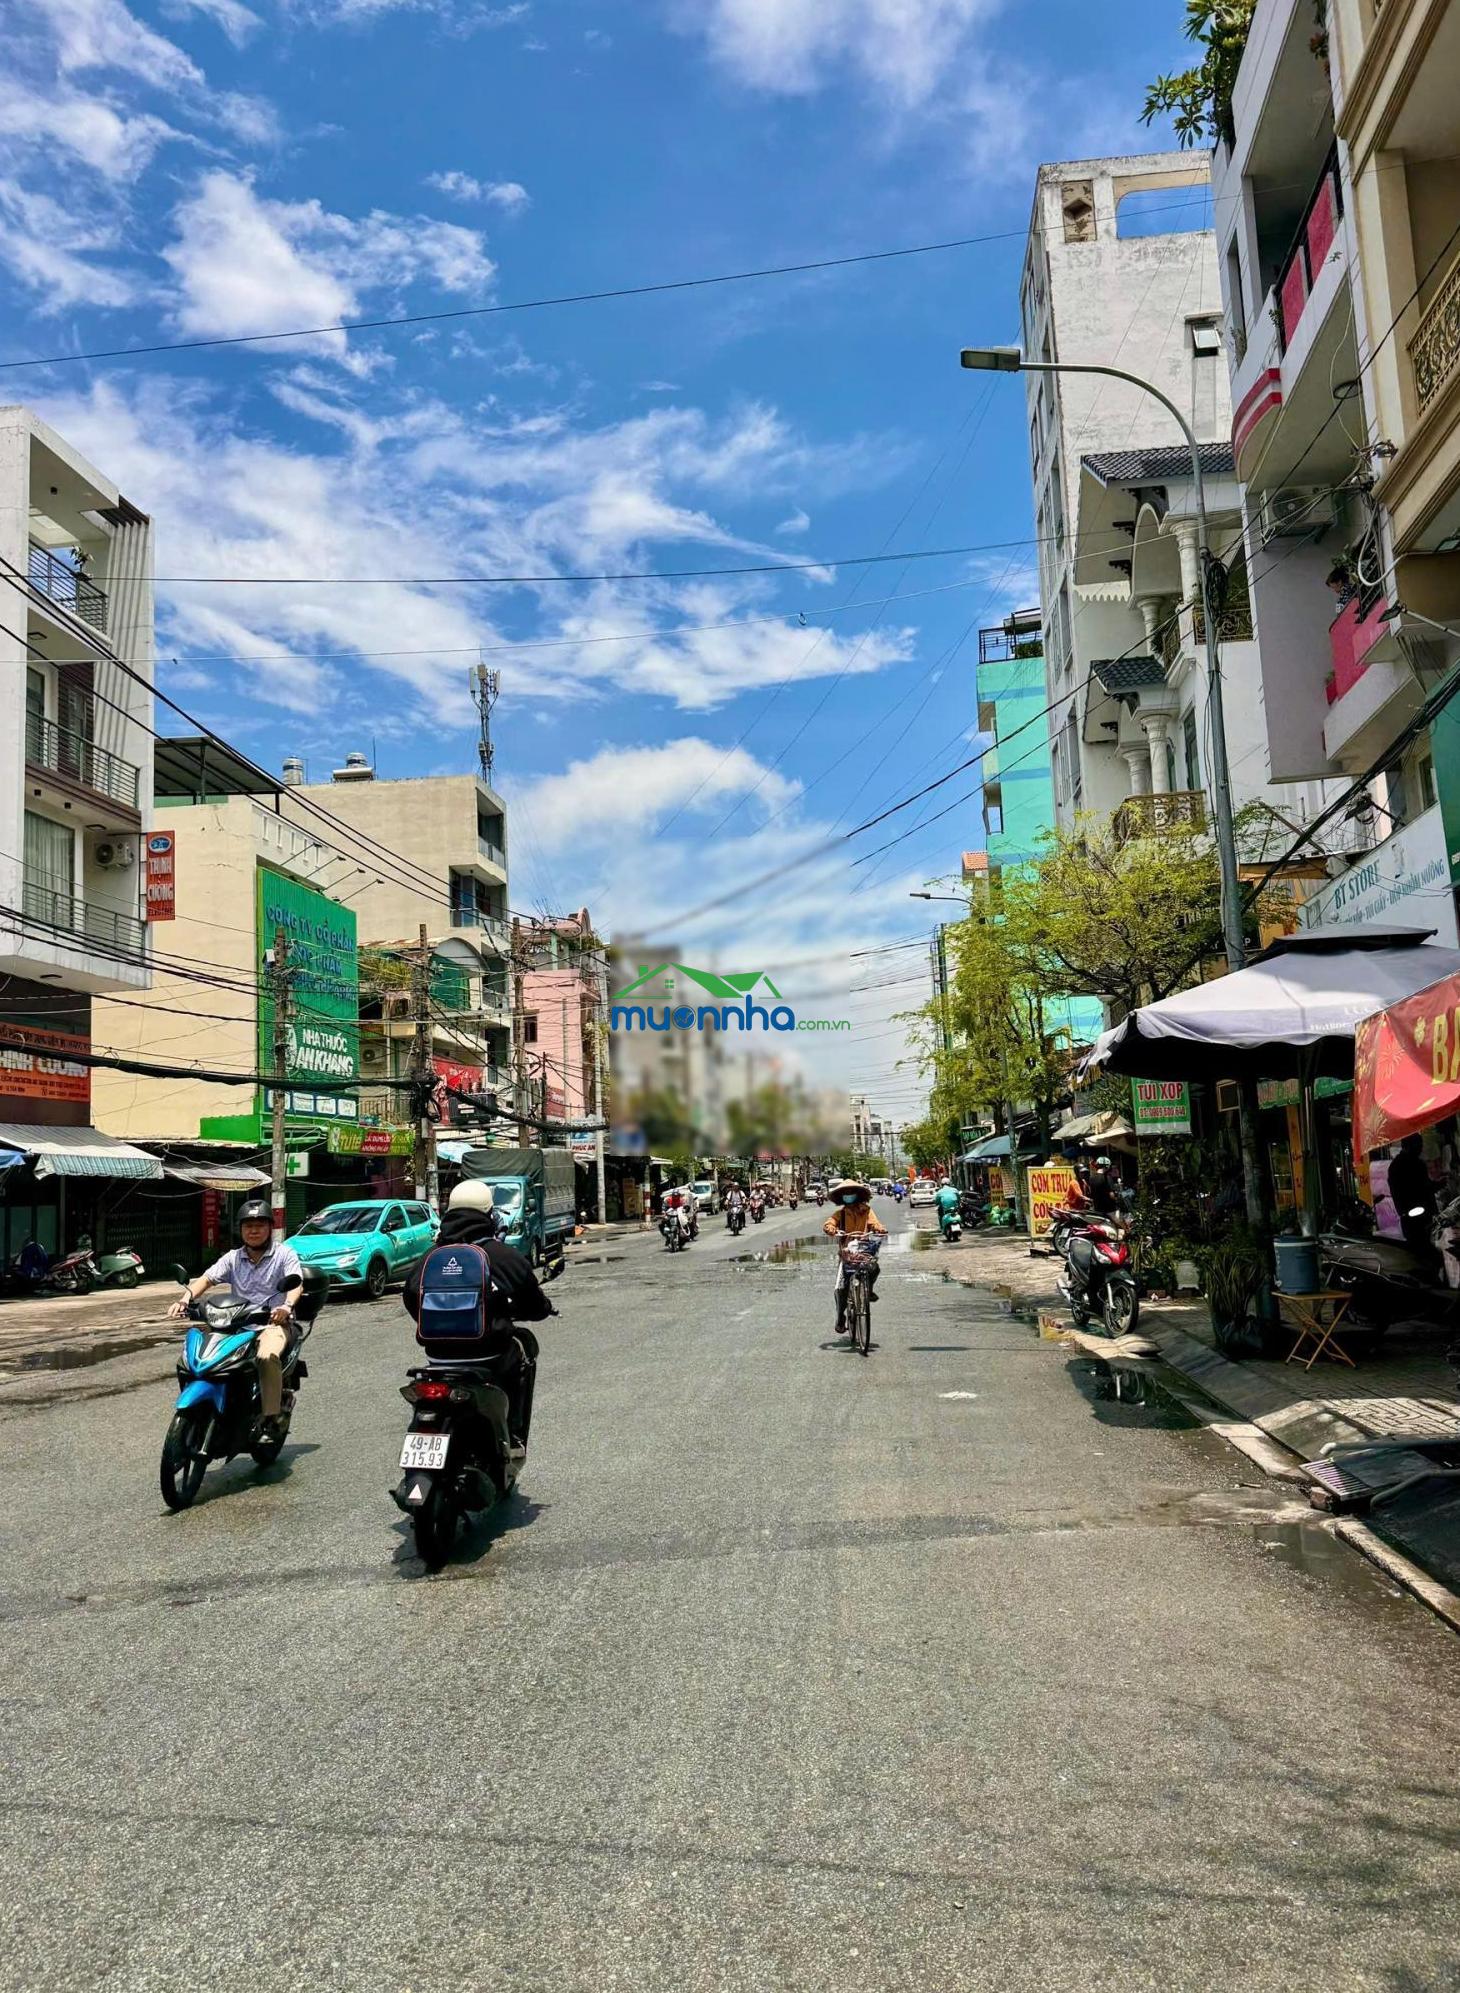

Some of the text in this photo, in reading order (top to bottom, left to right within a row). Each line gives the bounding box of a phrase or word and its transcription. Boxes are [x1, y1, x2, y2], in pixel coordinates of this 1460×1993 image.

[1334, 883, 1347, 909] BT
[410, 1436, 442, 1451] 49-AB
[402, 1451, 444, 1467] 315.93
